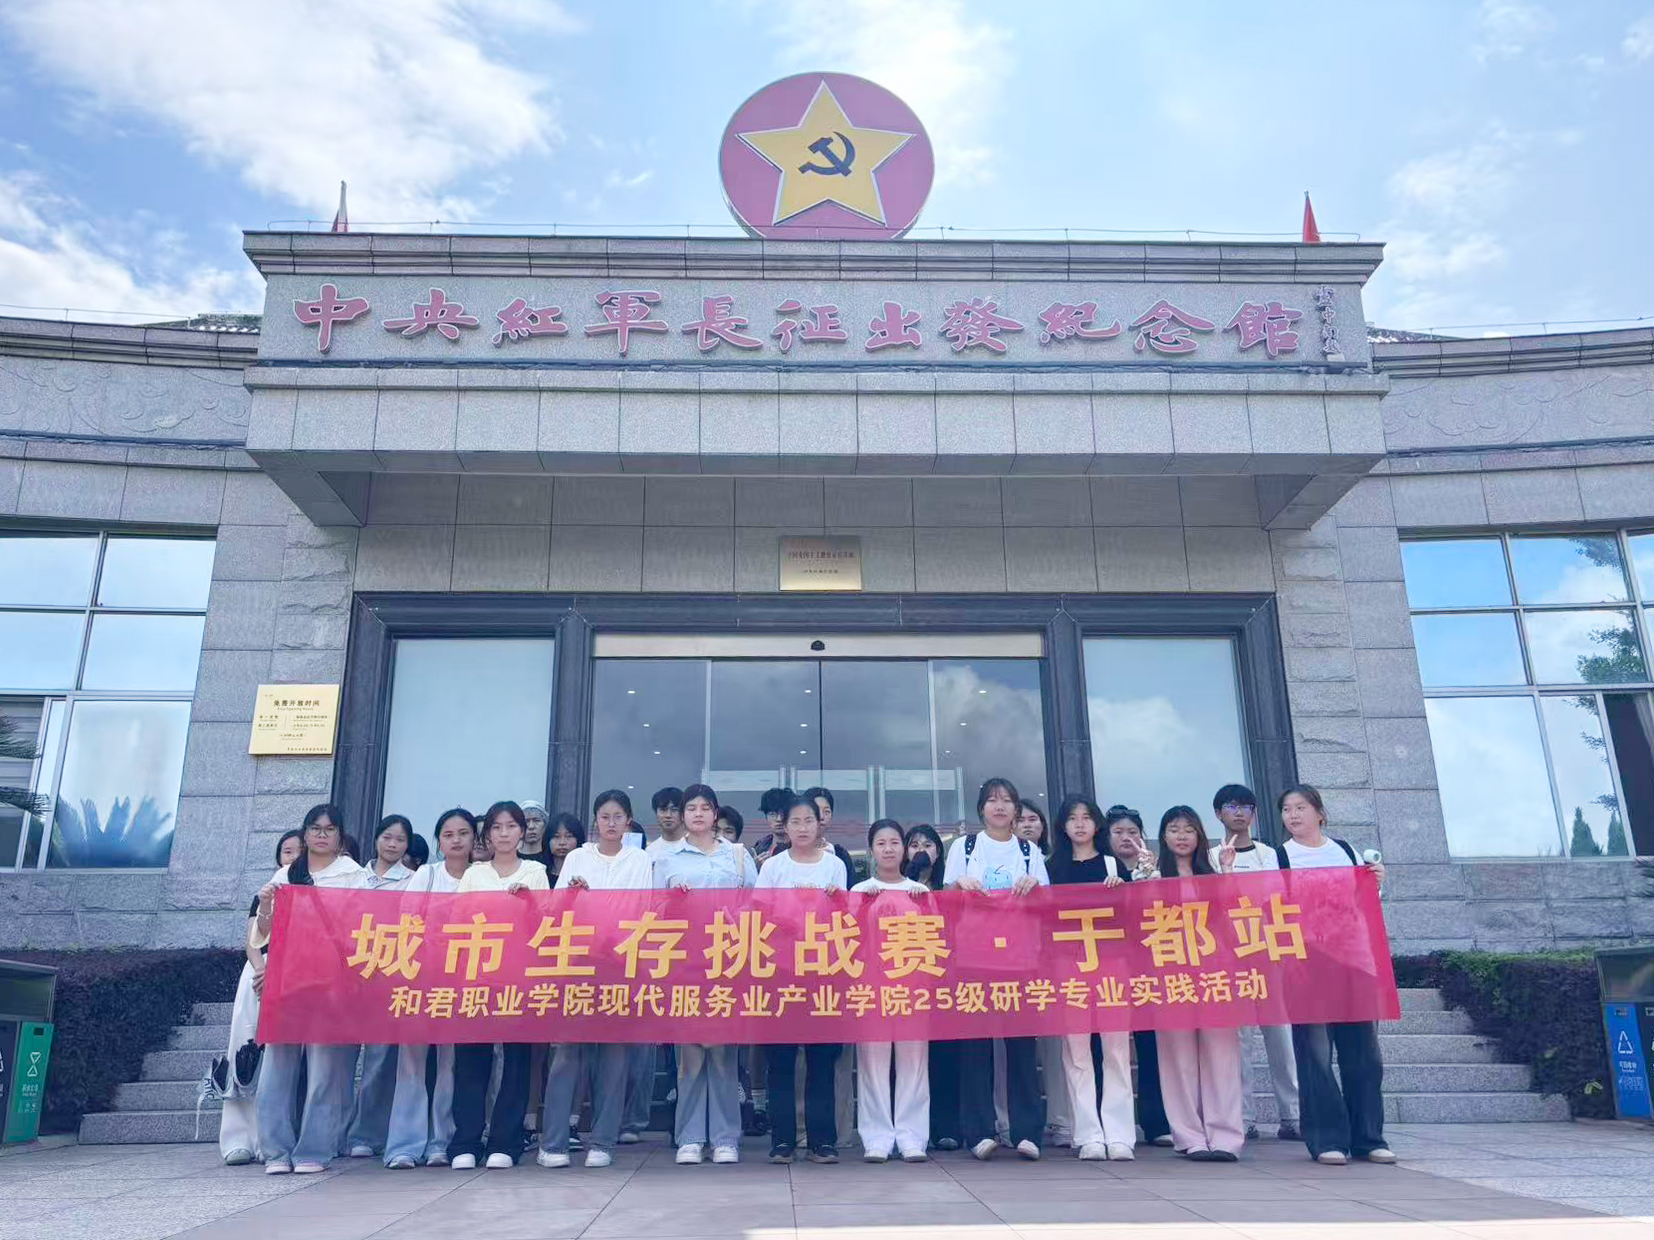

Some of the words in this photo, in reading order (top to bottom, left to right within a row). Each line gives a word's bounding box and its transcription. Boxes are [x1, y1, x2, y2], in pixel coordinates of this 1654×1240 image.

[293, 283, 1303, 358] 中央紅軍長征出發紀念館
[388, 967, 1269, 1018] 和君职业学院现代服务业产业学院25级研学专业实践活动
